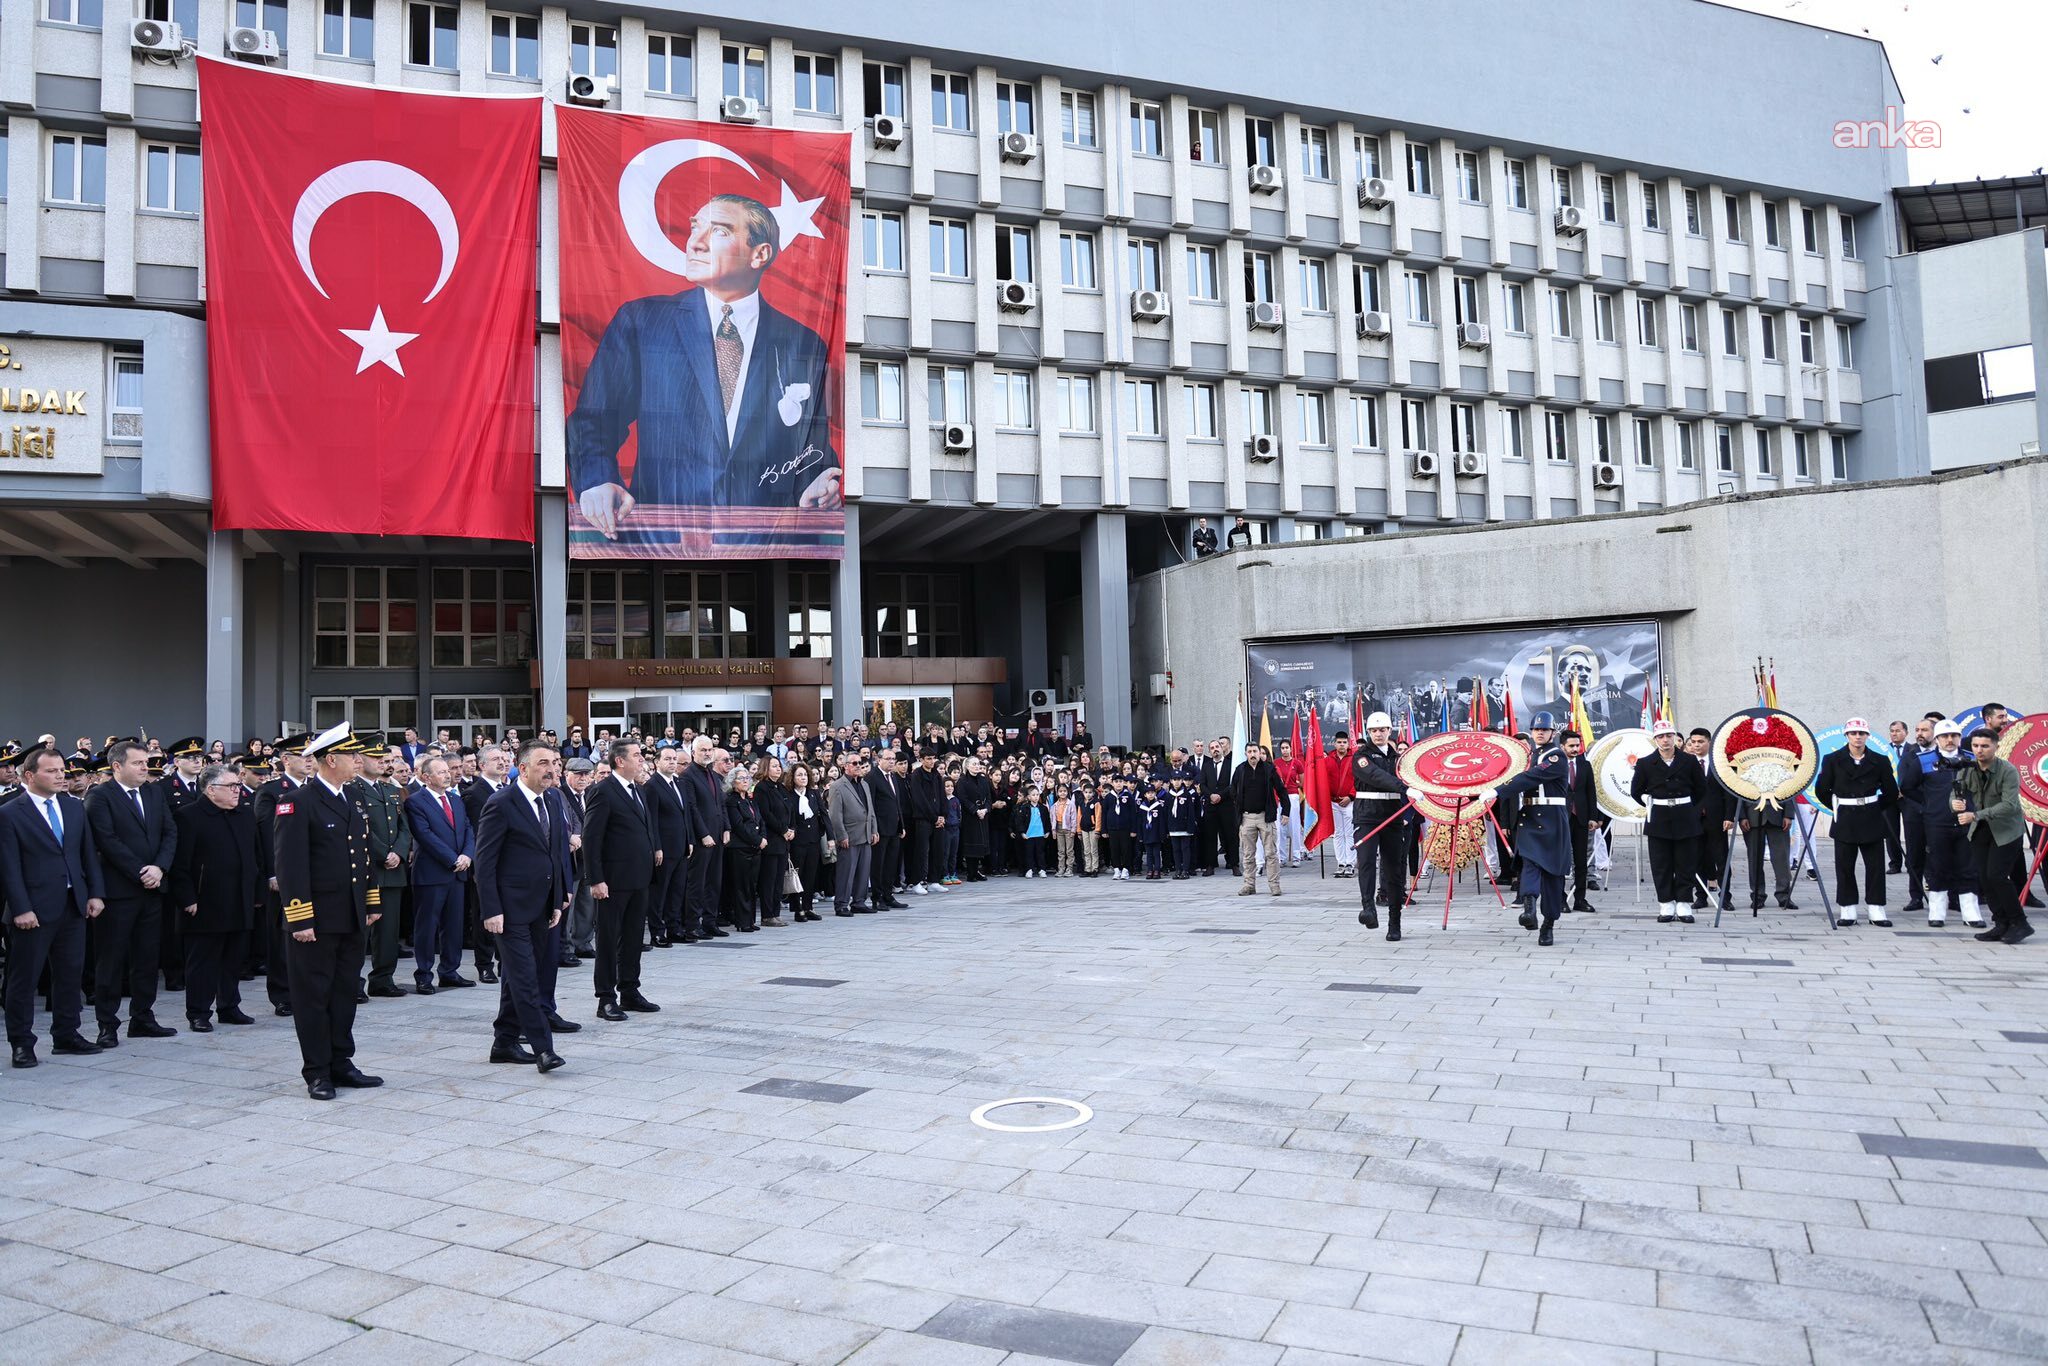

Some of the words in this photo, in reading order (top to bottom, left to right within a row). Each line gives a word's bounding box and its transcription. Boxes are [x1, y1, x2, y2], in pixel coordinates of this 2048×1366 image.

[656, 664, 722, 676] ZONGULDAK
[1591, 691, 1621, 699] KASIM
[1428, 742, 1503, 759] ZONGULDAK
